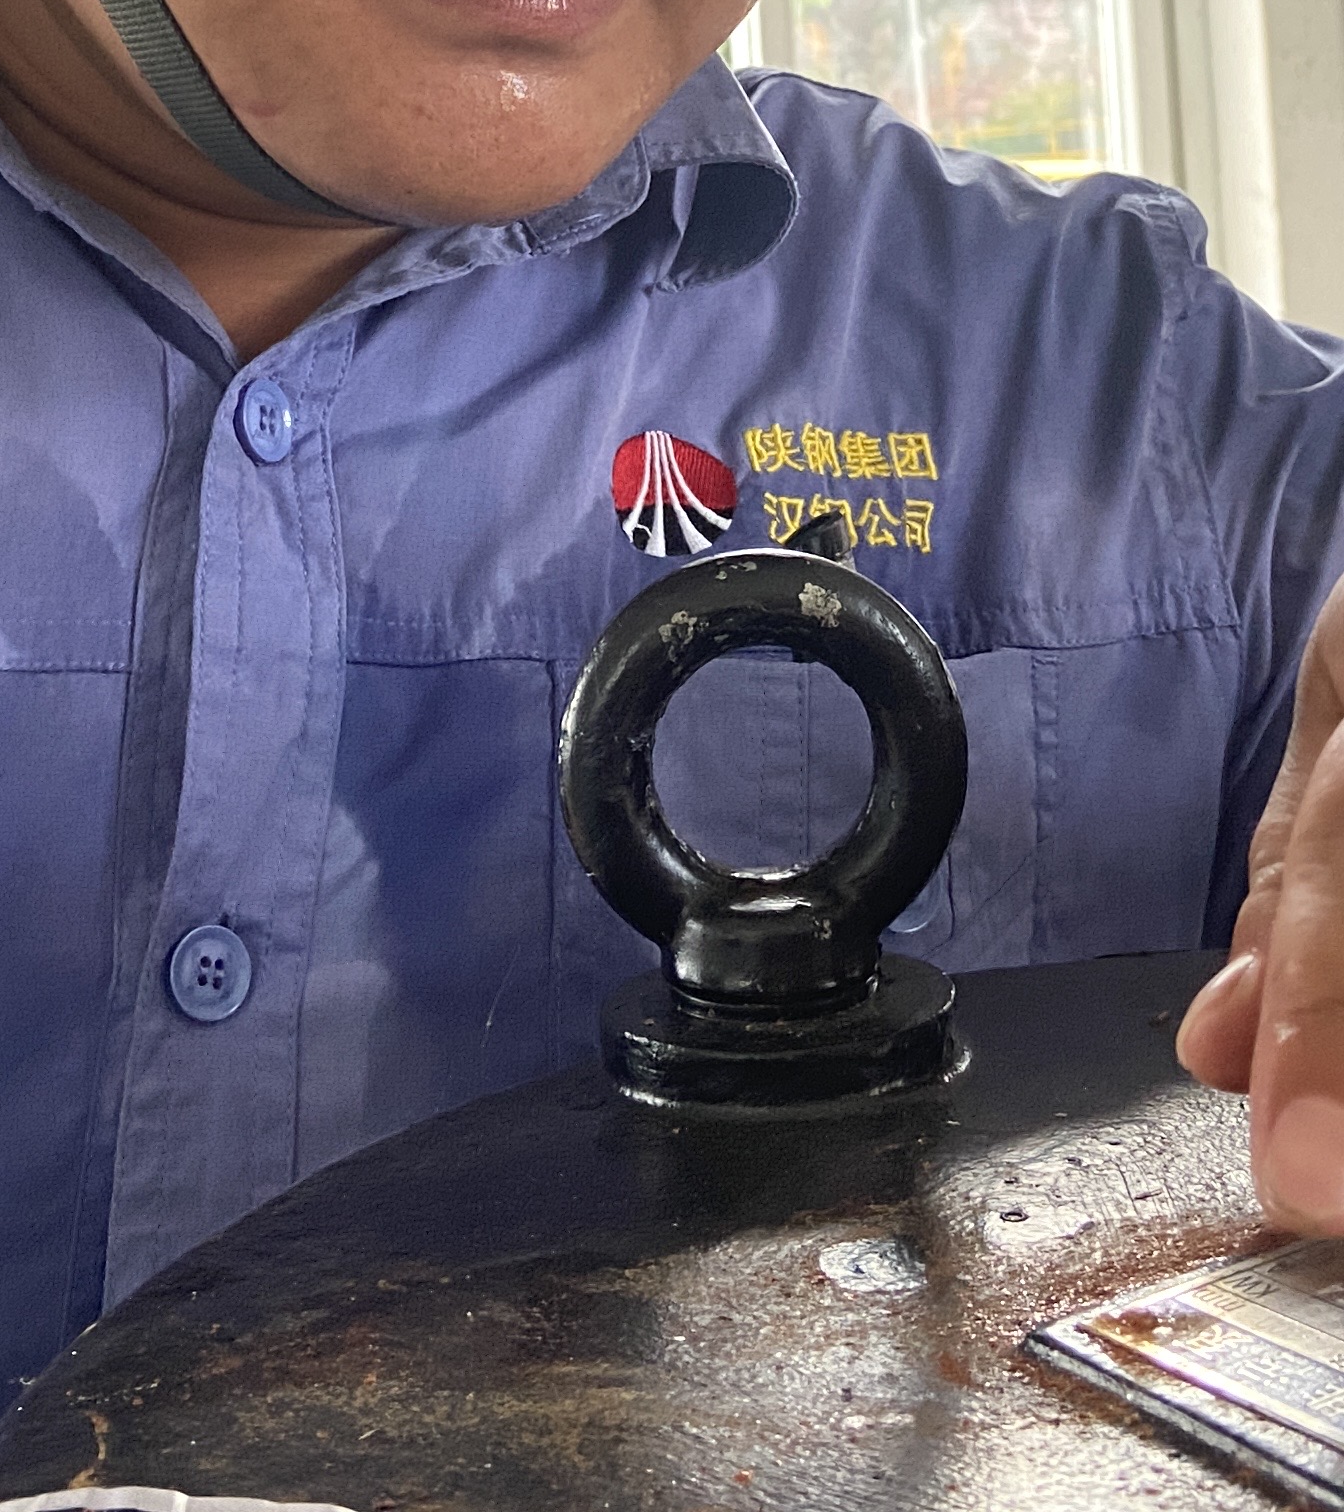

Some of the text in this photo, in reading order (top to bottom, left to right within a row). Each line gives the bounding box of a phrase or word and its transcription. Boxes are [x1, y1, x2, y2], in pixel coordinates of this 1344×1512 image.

[744, 422, 939, 481] 陕钢集团
[1224, 1272, 1280, 1299] KW
